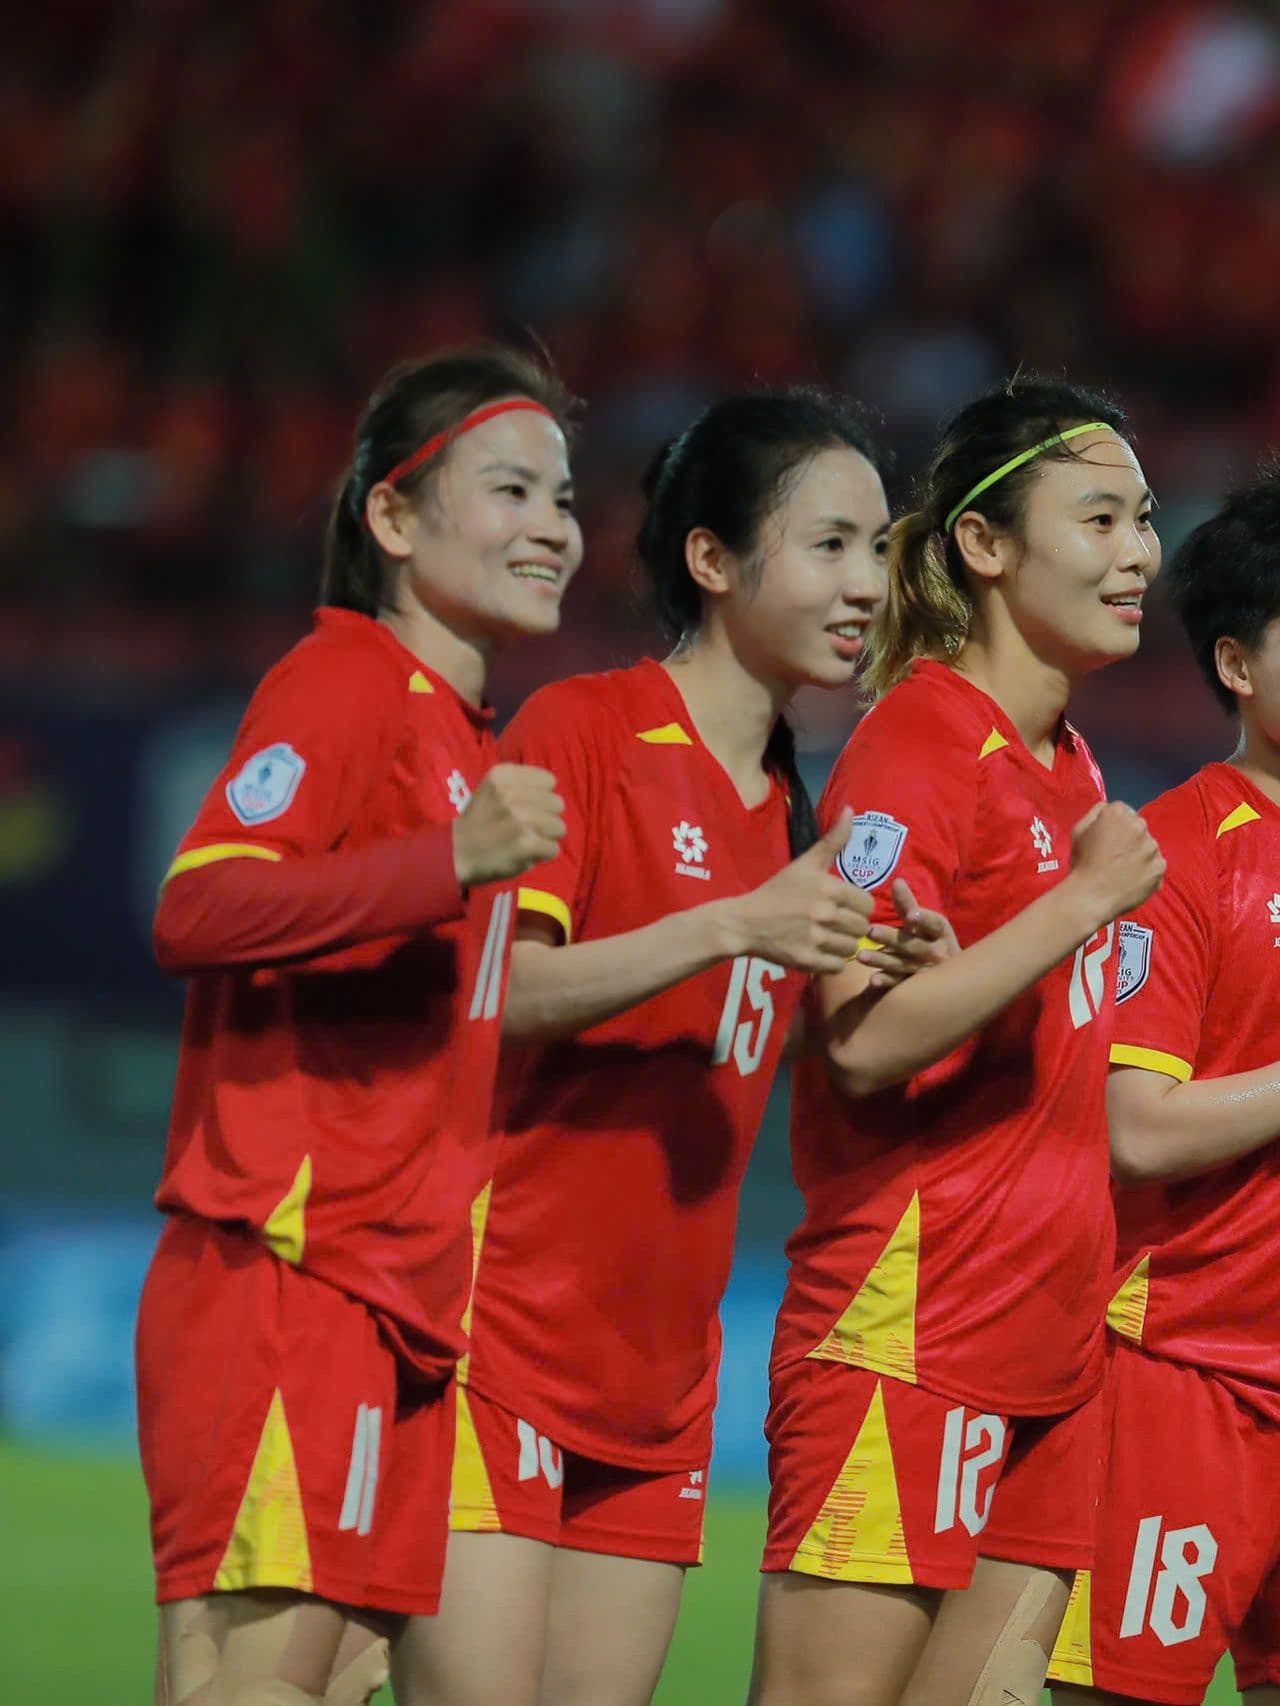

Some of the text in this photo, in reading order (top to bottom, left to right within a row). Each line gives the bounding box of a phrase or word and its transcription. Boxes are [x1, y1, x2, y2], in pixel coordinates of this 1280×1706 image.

[851, 868, 874, 878] CUP
[852, 855, 880, 866] MSIG
[469, 891, 512, 1020] 11
[1119, 923, 1134, 933] EAN
[713, 955, 786, 1077] 15
[338, 1403, 382, 1536] 11
[934, 1405, 1006, 1538] 12
[1119, 1515, 1219, 1647] 18
